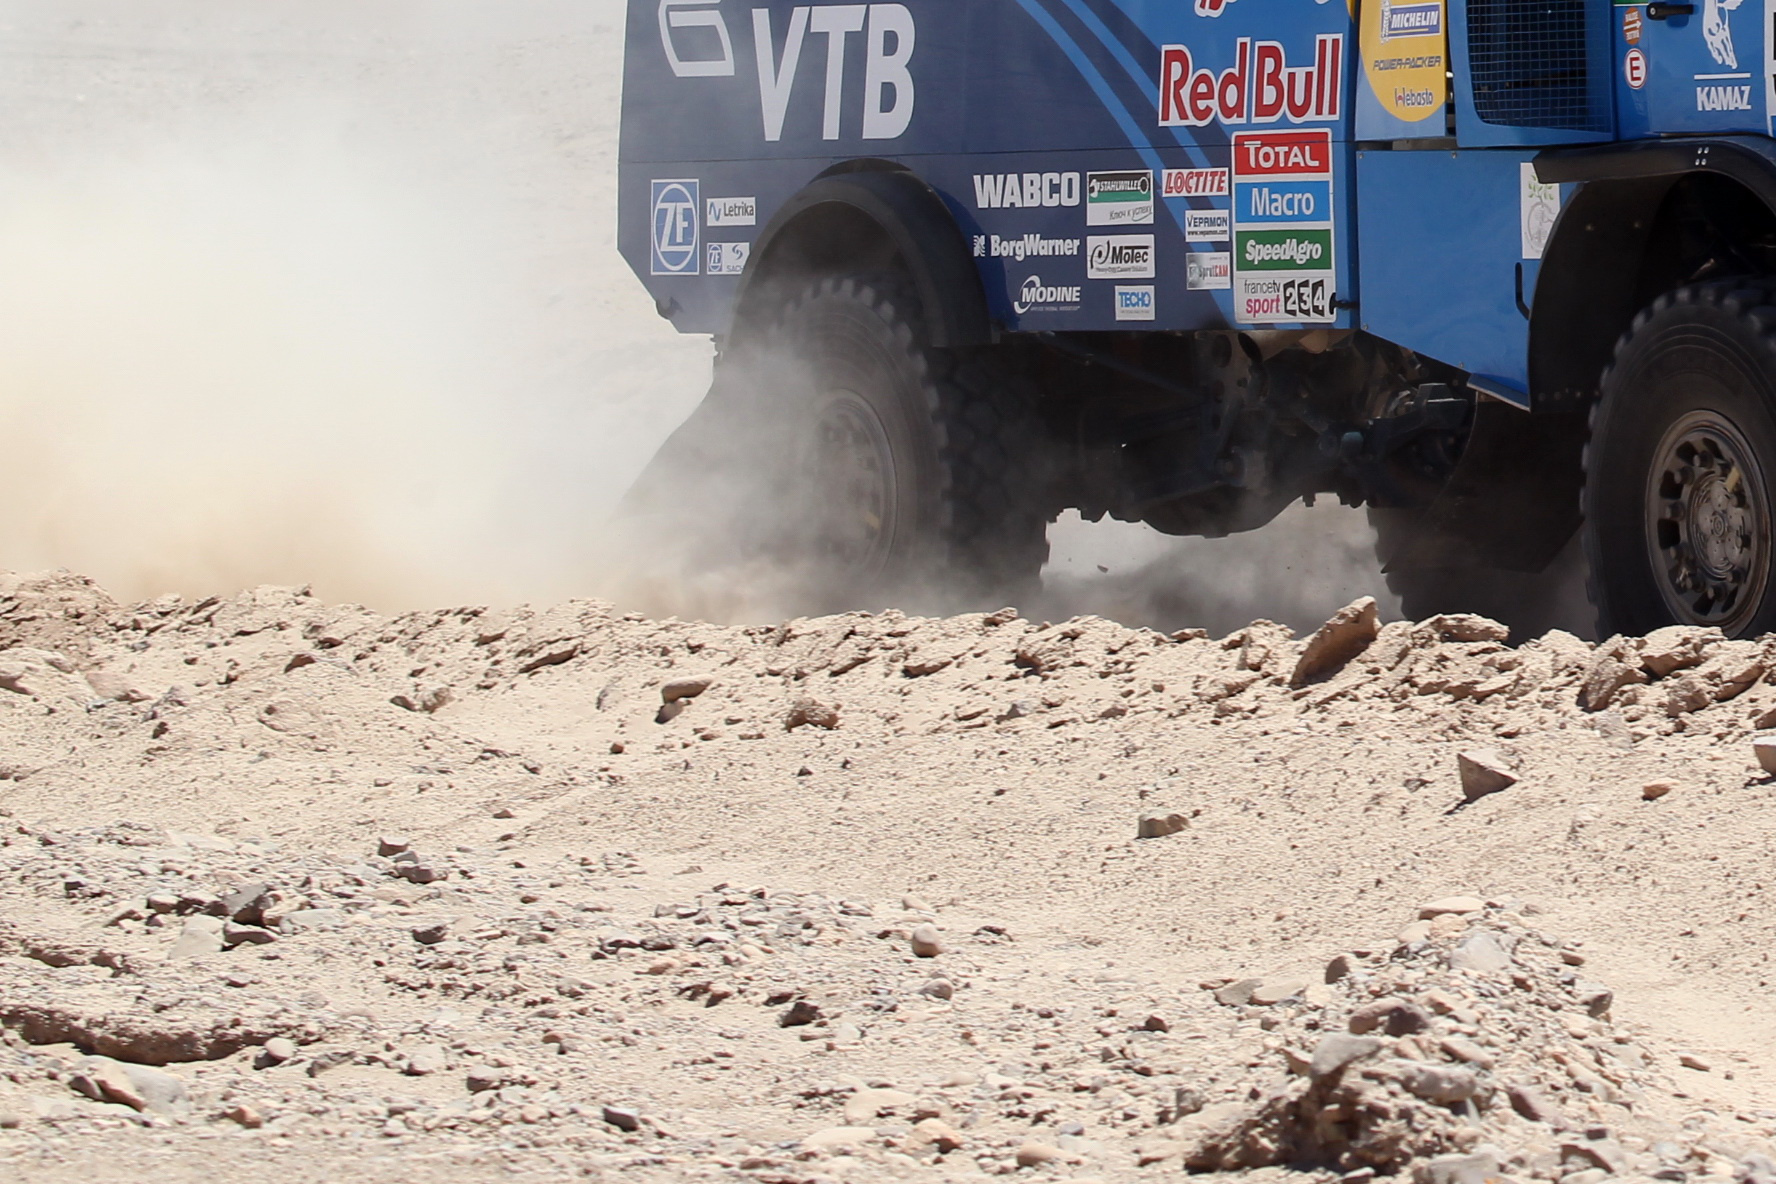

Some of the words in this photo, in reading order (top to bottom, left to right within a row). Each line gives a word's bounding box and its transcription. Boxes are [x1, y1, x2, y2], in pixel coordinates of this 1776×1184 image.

[1391, 11, 1438, 28] MICHELIN
[752, 3, 915, 141] VTB
[1159, 39, 1250, 125] Red
[1253, 36, 1343, 122] Bull
[1629, 57, 1641, 81] E
[1395, 87, 1434, 107] Webasto
[1696, 86, 1752, 111] KAMAZ
[1244, 141, 1320, 169] TOTAL
[973, 172, 1080, 208] WABCO
[1164, 170, 1227, 194] LOCTITE
[723, 201, 755, 217] Letrika
[1251, 187, 1314, 216] Macro
[1187, 214, 1228, 227] VEPAMON
[990, 234, 1080, 261] BorgWarner
[1245, 239, 1322, 265] SpeedAgro
[1022, 286, 1081, 303] MODINE
[1246, 294, 1280, 318] sport
